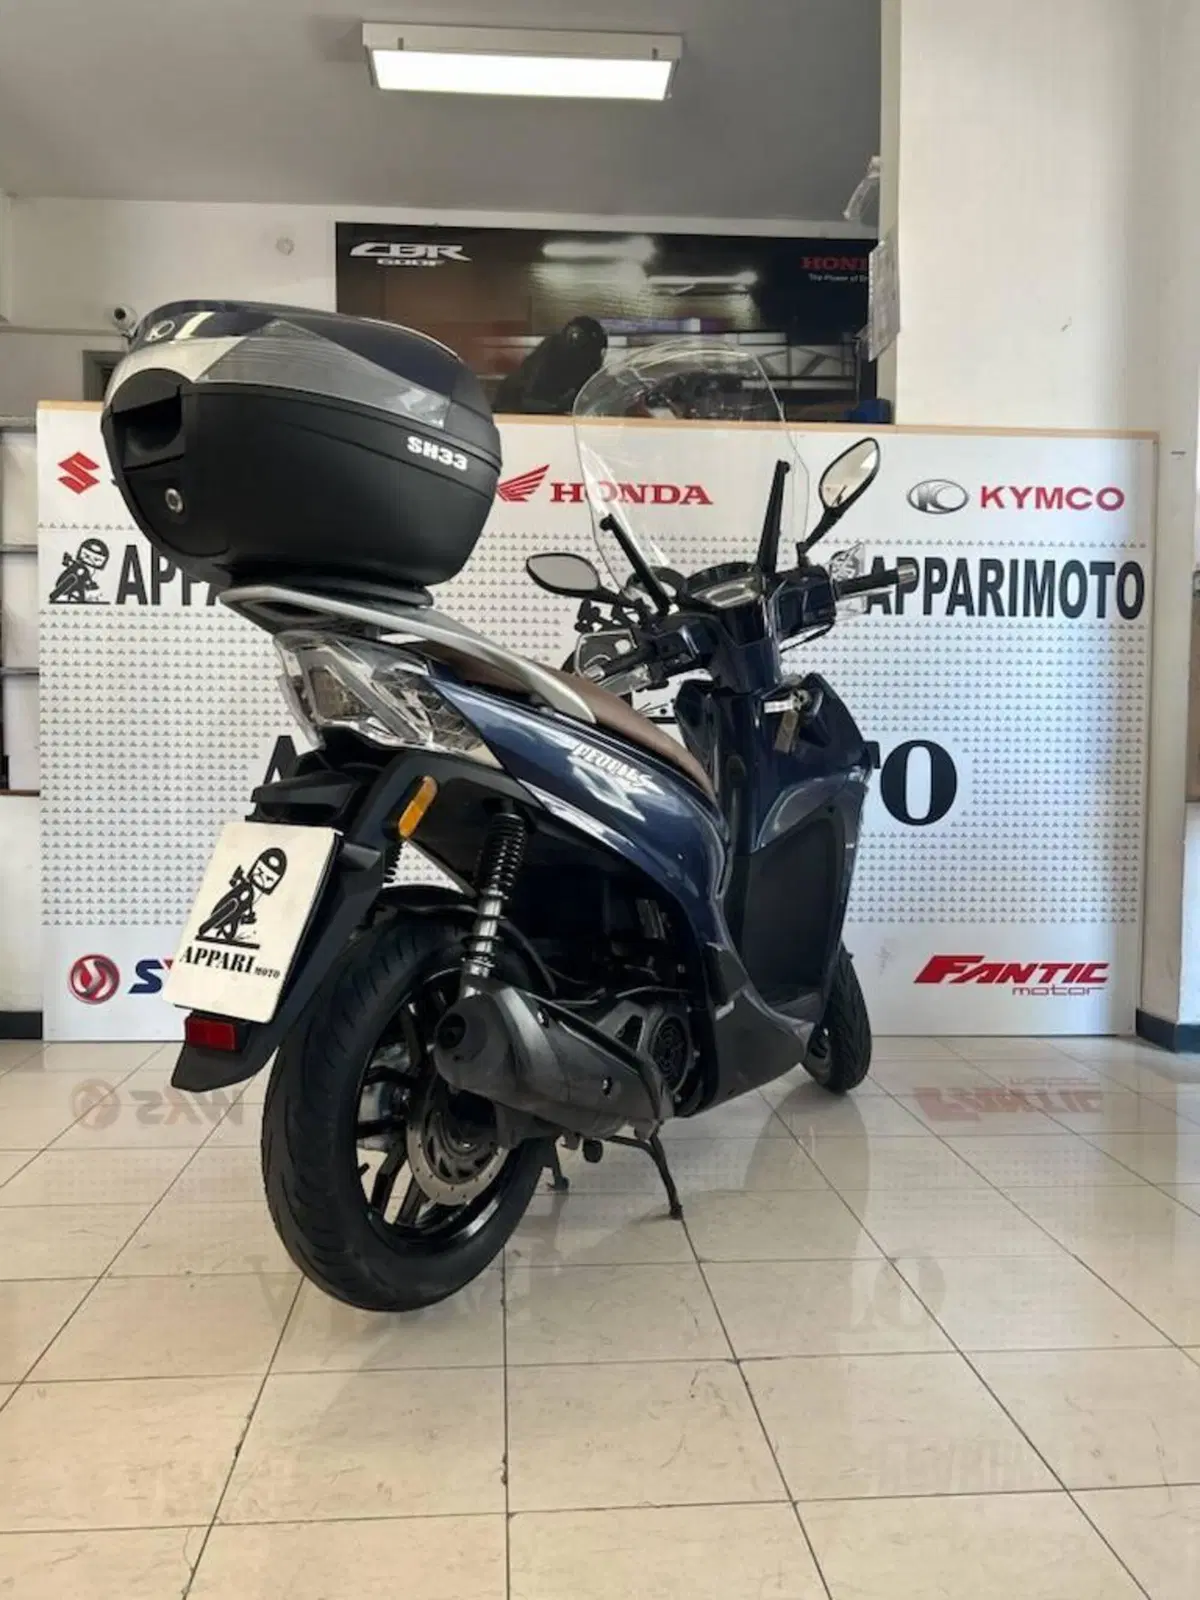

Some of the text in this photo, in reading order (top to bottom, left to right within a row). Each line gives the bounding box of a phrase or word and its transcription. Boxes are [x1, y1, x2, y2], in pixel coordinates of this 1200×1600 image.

[350, 242, 472, 261] CBR
[407, 436, 468, 471] SH33
[981, 486, 1125, 511] KYMCO
[180, 946, 281, 980] APPARI MOTO
[914, 955, 1110, 984] FANTIC
[1012, 984, 1106, 997] motor
